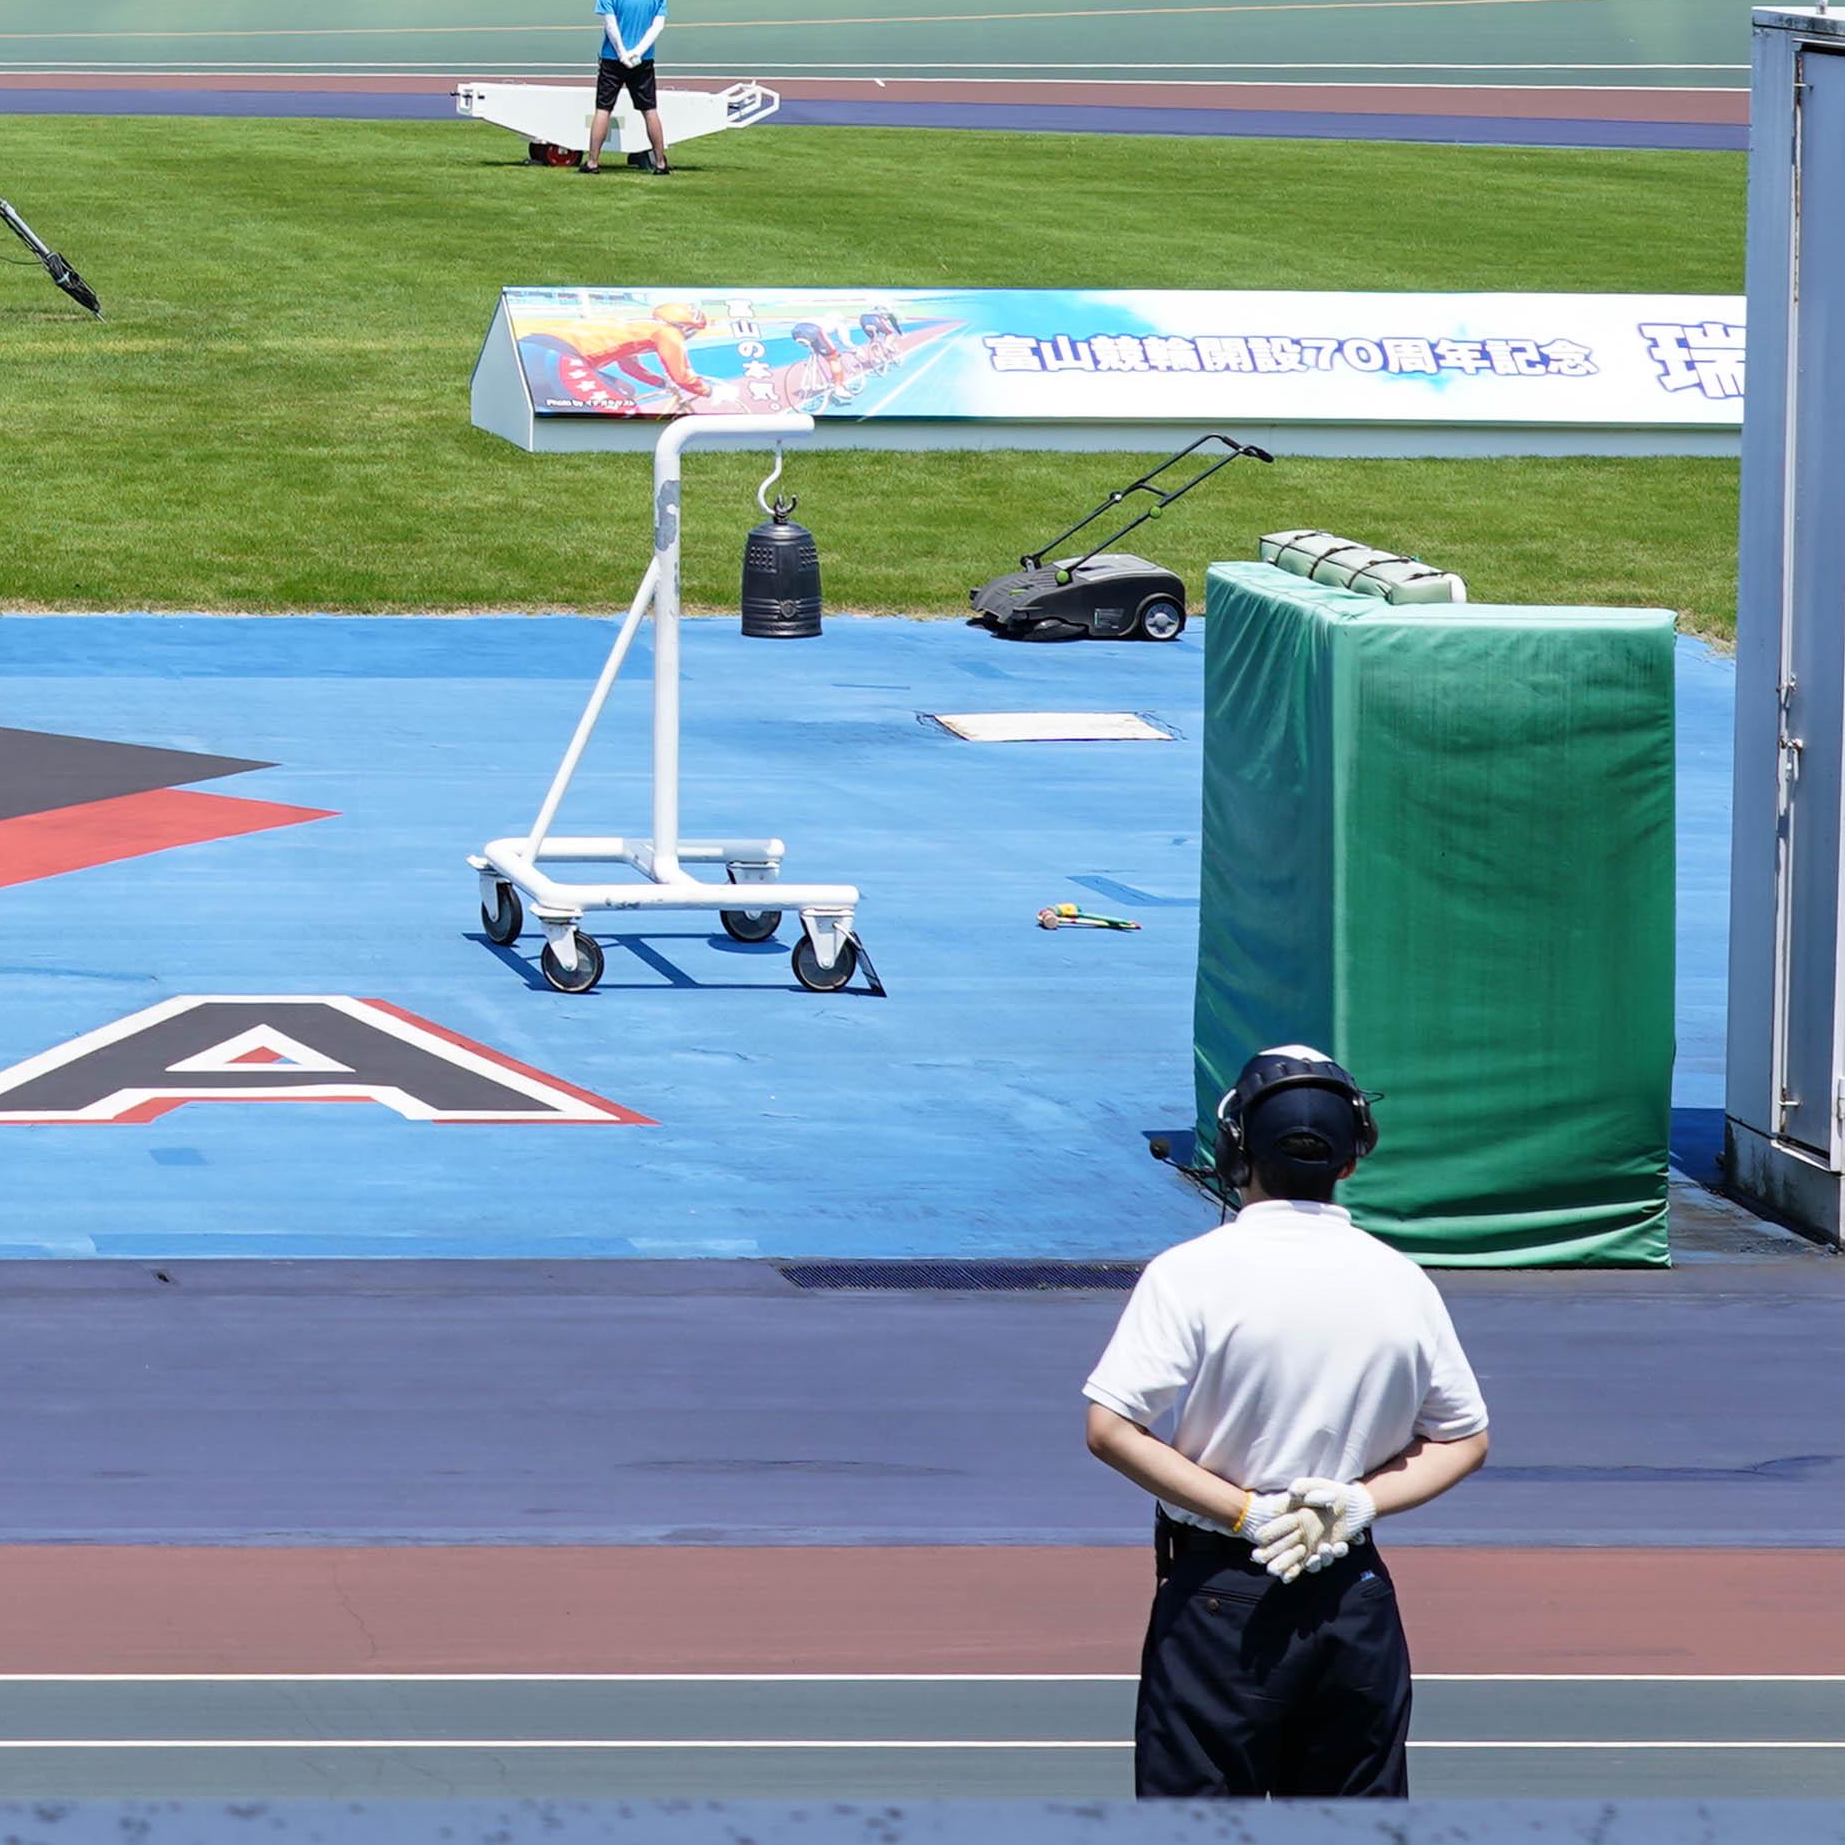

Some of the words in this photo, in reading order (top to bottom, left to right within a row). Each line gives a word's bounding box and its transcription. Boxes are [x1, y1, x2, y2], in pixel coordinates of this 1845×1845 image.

[724, 298, 780, 412] 富山の本気。
[983, 333, 1600, 378] 富山競輪開設70周年記念
